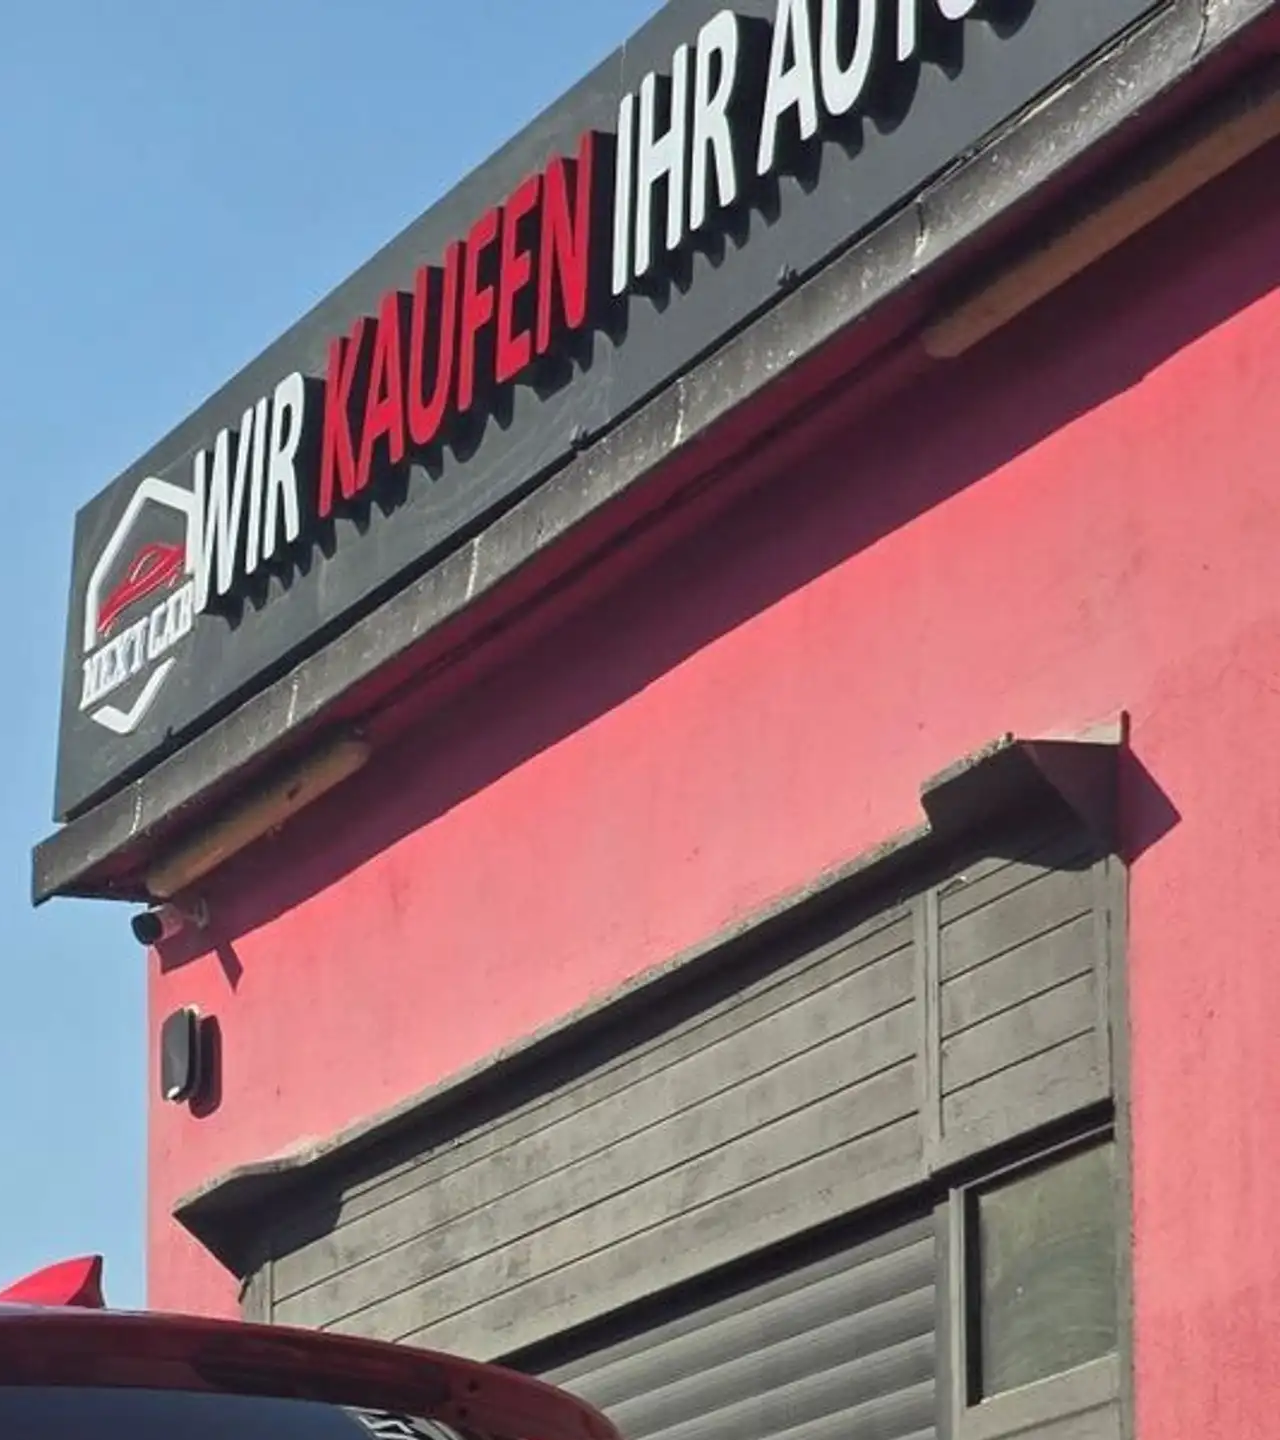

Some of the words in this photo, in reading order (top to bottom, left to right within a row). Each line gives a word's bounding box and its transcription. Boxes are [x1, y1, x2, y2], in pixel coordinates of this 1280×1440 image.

[192, 371, 306, 614] WIR
[318, 130, 593, 519] KAUFEN
[611, 9, 738, 296] IHR
